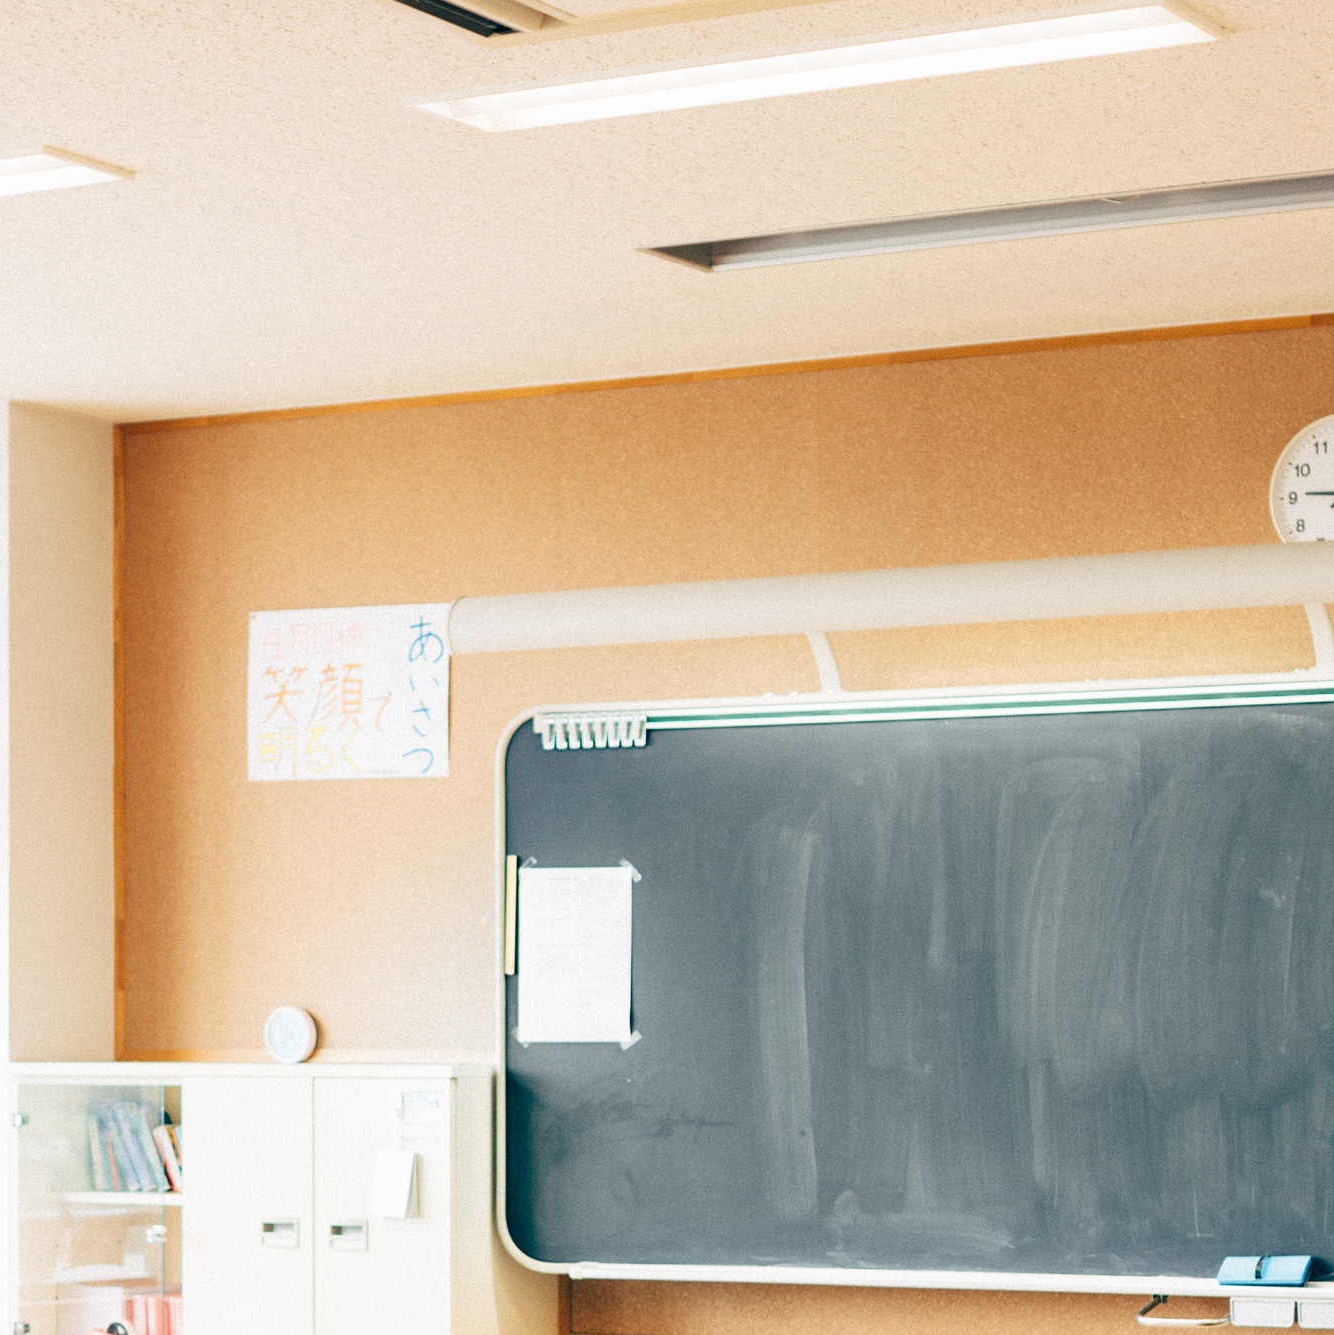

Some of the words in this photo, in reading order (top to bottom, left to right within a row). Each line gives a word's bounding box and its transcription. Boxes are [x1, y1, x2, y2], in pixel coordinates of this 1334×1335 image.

[1314, 441, 1328, 454] 11
[1295, 463, 1311, 477] 10
[1288, 491, 1298, 505] 9
[1296, 519, 1305, 532] 8
[402, 616, 444, 774] あいさつ
[259, 726, 361, 777] 明るく
